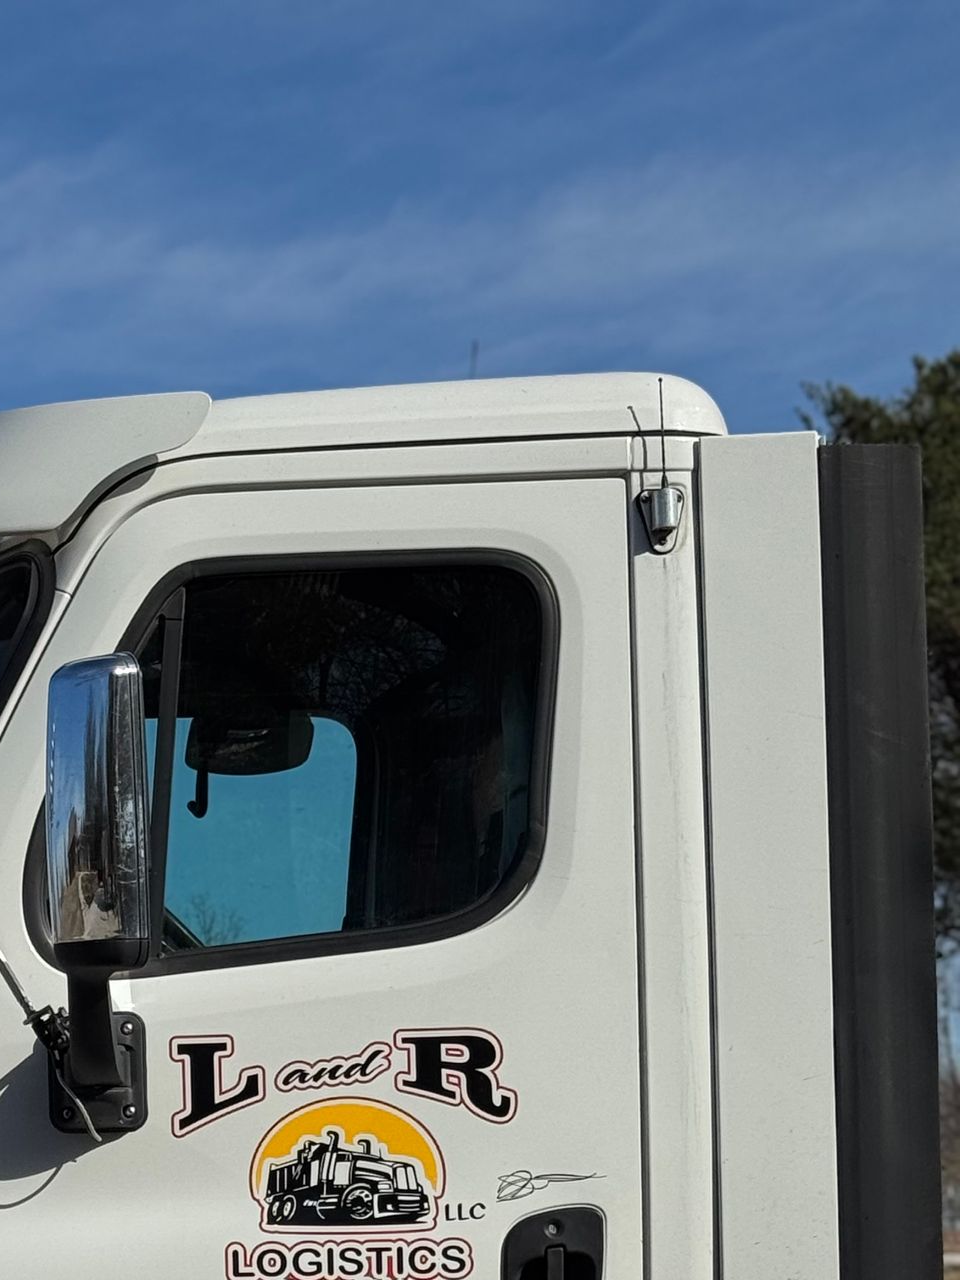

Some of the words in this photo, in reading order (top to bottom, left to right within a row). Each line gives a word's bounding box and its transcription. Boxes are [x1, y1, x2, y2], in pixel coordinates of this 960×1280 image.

[175, 1041, 261, 1134] L
[277, 1045, 388, 1090] and
[398, 1034, 513, 1121] R
[444, 1202, 486, 1221] LLC
[230, 1243, 468, 1278] LOGISTICS
